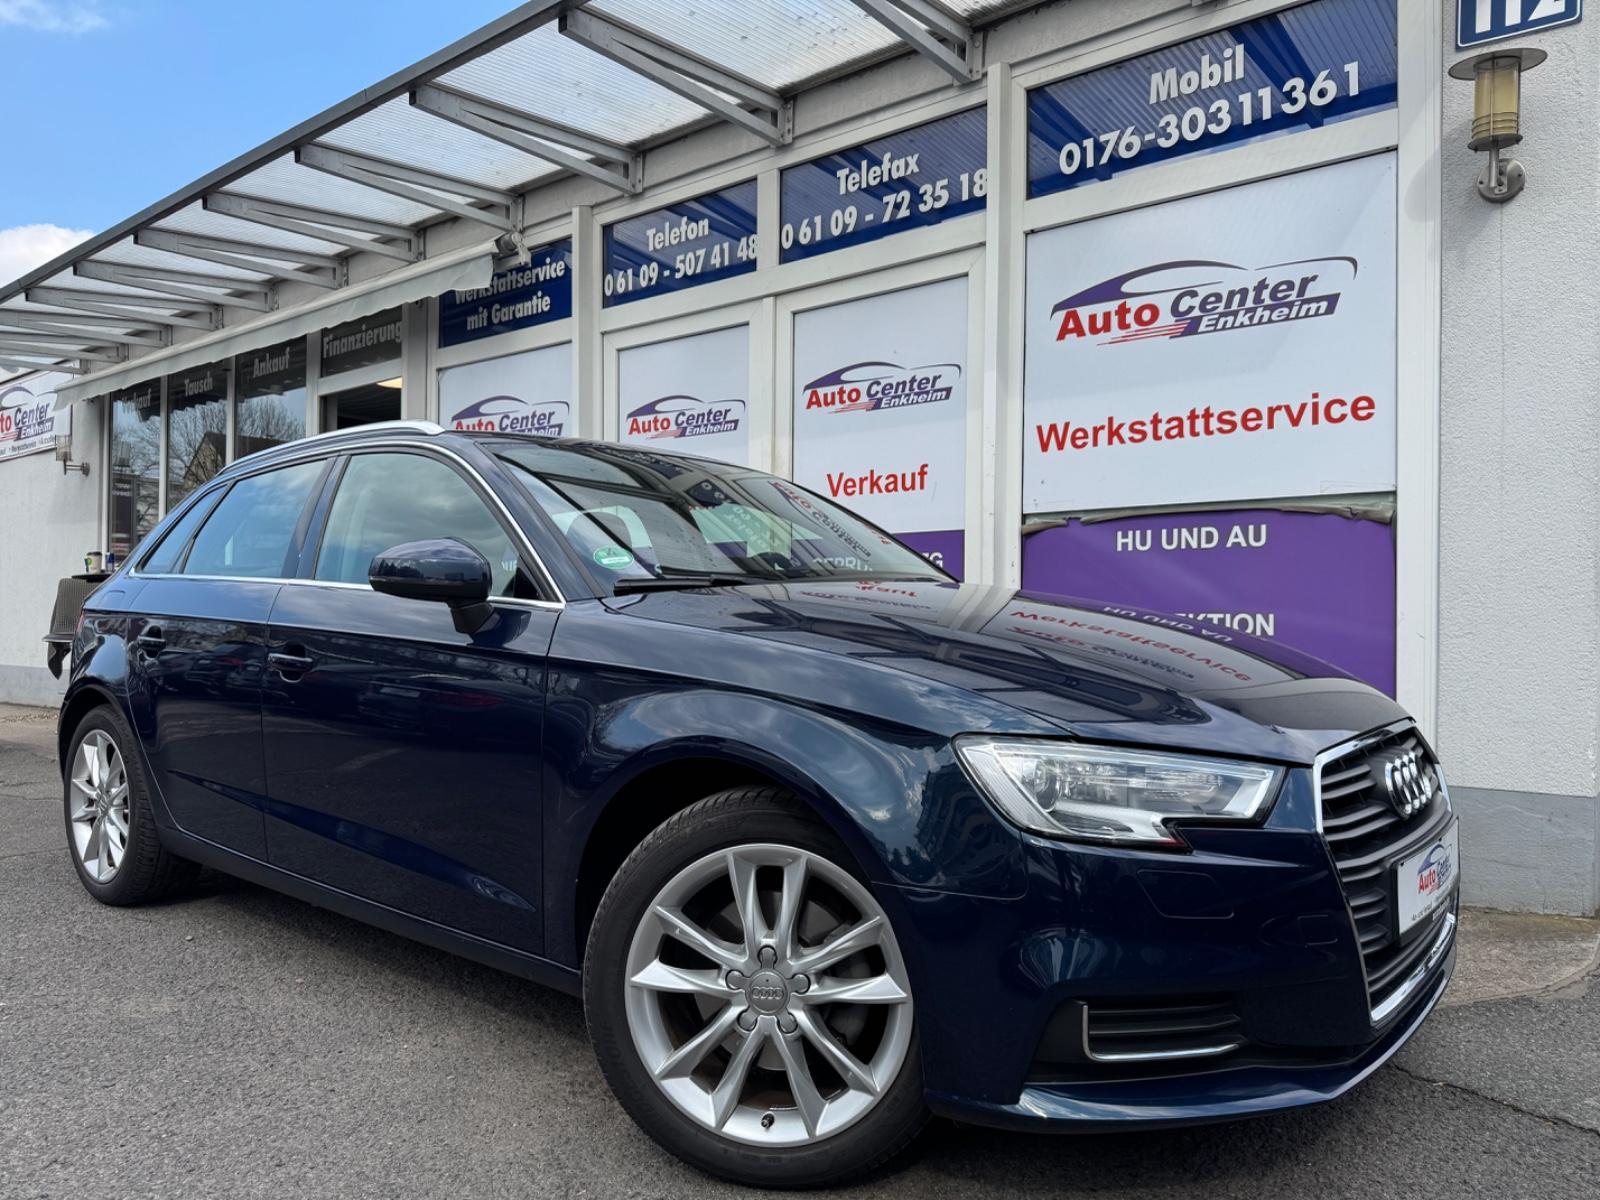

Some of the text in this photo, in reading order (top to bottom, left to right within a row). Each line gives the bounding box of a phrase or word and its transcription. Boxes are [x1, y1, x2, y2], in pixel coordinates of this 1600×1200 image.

[1150, 44, 1245, 104] Mobil
[837, 152, 920, 195] Telefax
[646, 216, 709, 251] Telefon
[675, 248, 706, 279] 507
[467, 290, 551, 331] mit Garantie
[1056, 274, 1318, 342] Auto Center
[1198, 300, 1328, 333] Enkheim
[323, 321, 401, 358] Finanzierung
[253, 346, 290, 378] Ankauf
[185, 371, 213, 397] Tausch
[806, 374, 942, 409] Auto Center
[880, 390, 946, 409] Enkheim
[14, 402, 50, 427] Center
[499, 410, 555, 432] Center
[628, 408, 731, 435] Auto Center
[685, 422, 734, 436] Enkheim
[1036, 393, 1375, 452] Werkstattservice
[827, 464, 928, 497] Verkauf
[1116, 524, 1266, 552] HU UND AU
[1418, 868, 1436, 894] Auto
